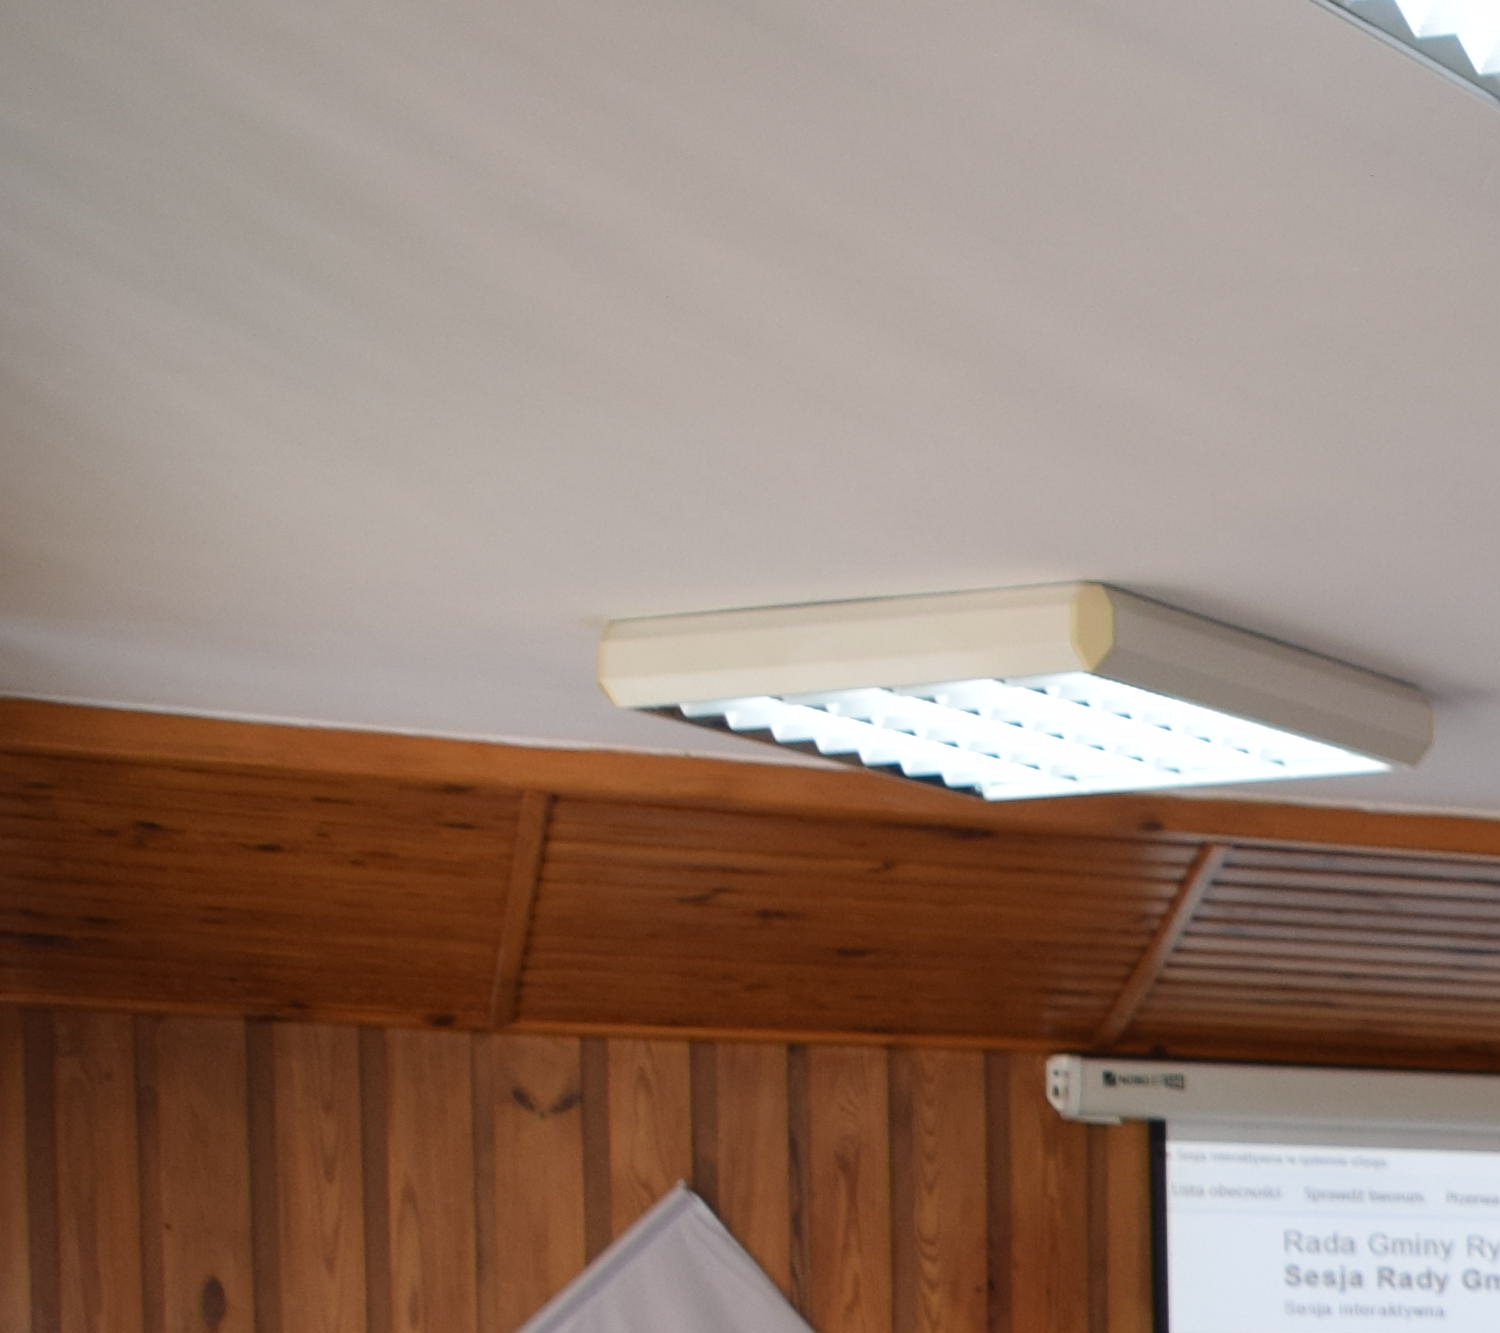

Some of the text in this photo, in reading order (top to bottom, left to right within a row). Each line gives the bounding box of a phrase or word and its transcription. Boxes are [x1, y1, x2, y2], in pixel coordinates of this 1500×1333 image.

[1283, 1230, 1356, 1256] Rada
[1368, 1232, 1455, 1260] Gminy
[1283, 1264, 1364, 1294] Sesja
[1376, 1266, 1449, 1292] Rady
[1284, 1302, 1446, 1320] Sesja interaktywna
